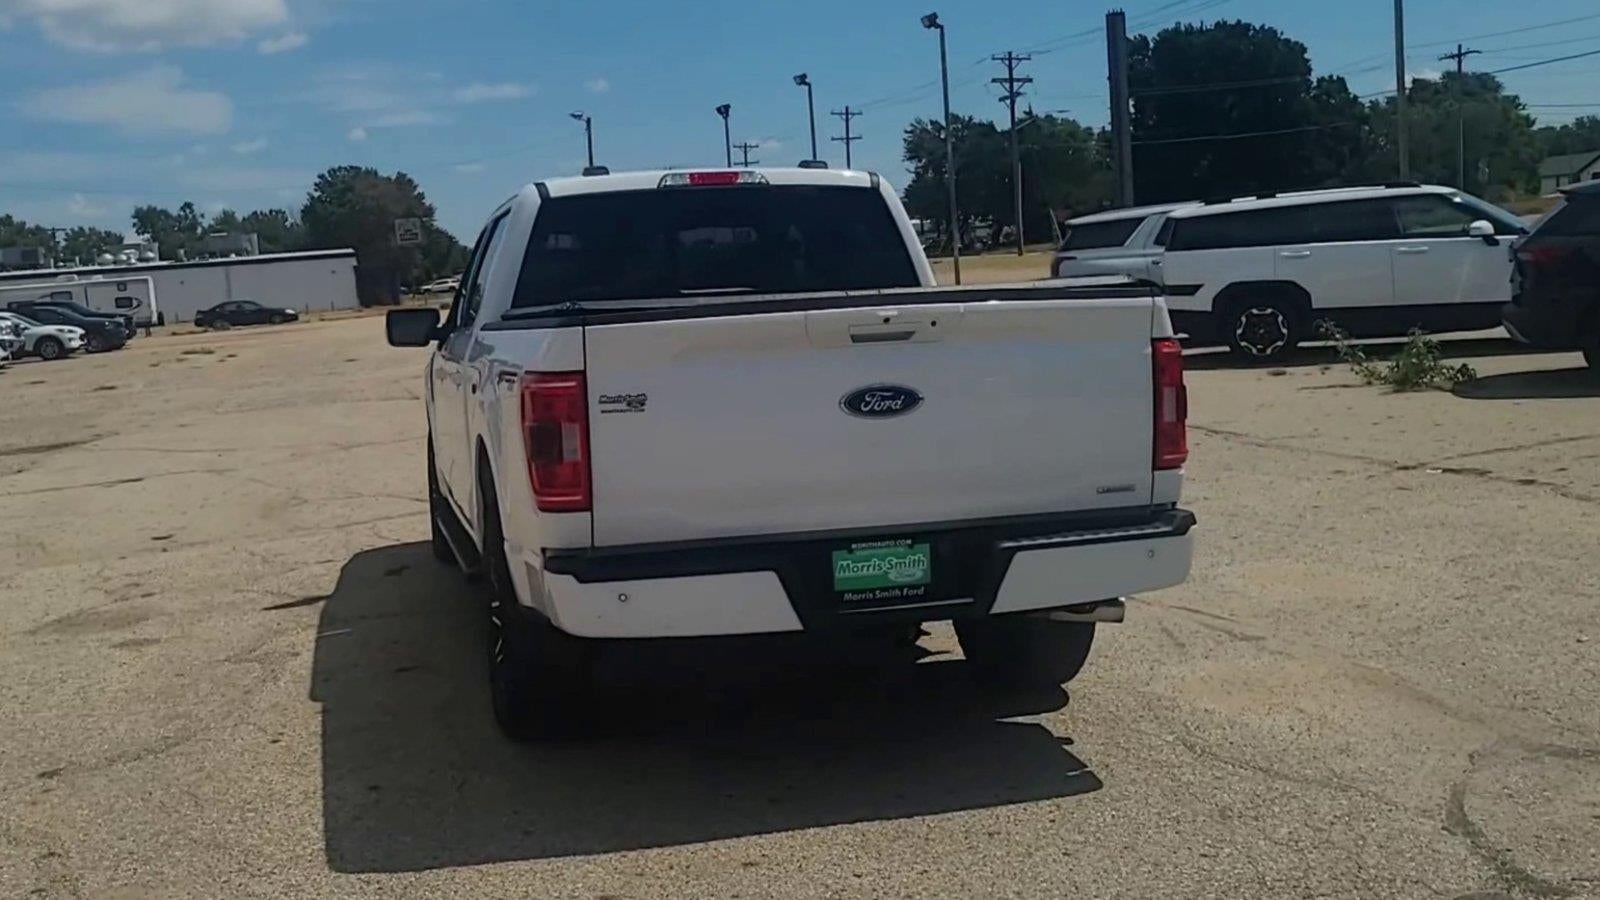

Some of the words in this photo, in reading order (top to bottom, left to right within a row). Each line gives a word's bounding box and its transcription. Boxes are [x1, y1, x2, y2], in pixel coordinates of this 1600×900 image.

[861, 391, 905, 411] Ford
[836, 558, 884, 577] Morris
[884, 554, 927, 571] Smith
[843, 591, 873, 601] Morris
[874, 589, 901, 599] Smith
[902, 586, 925, 596] Ford
